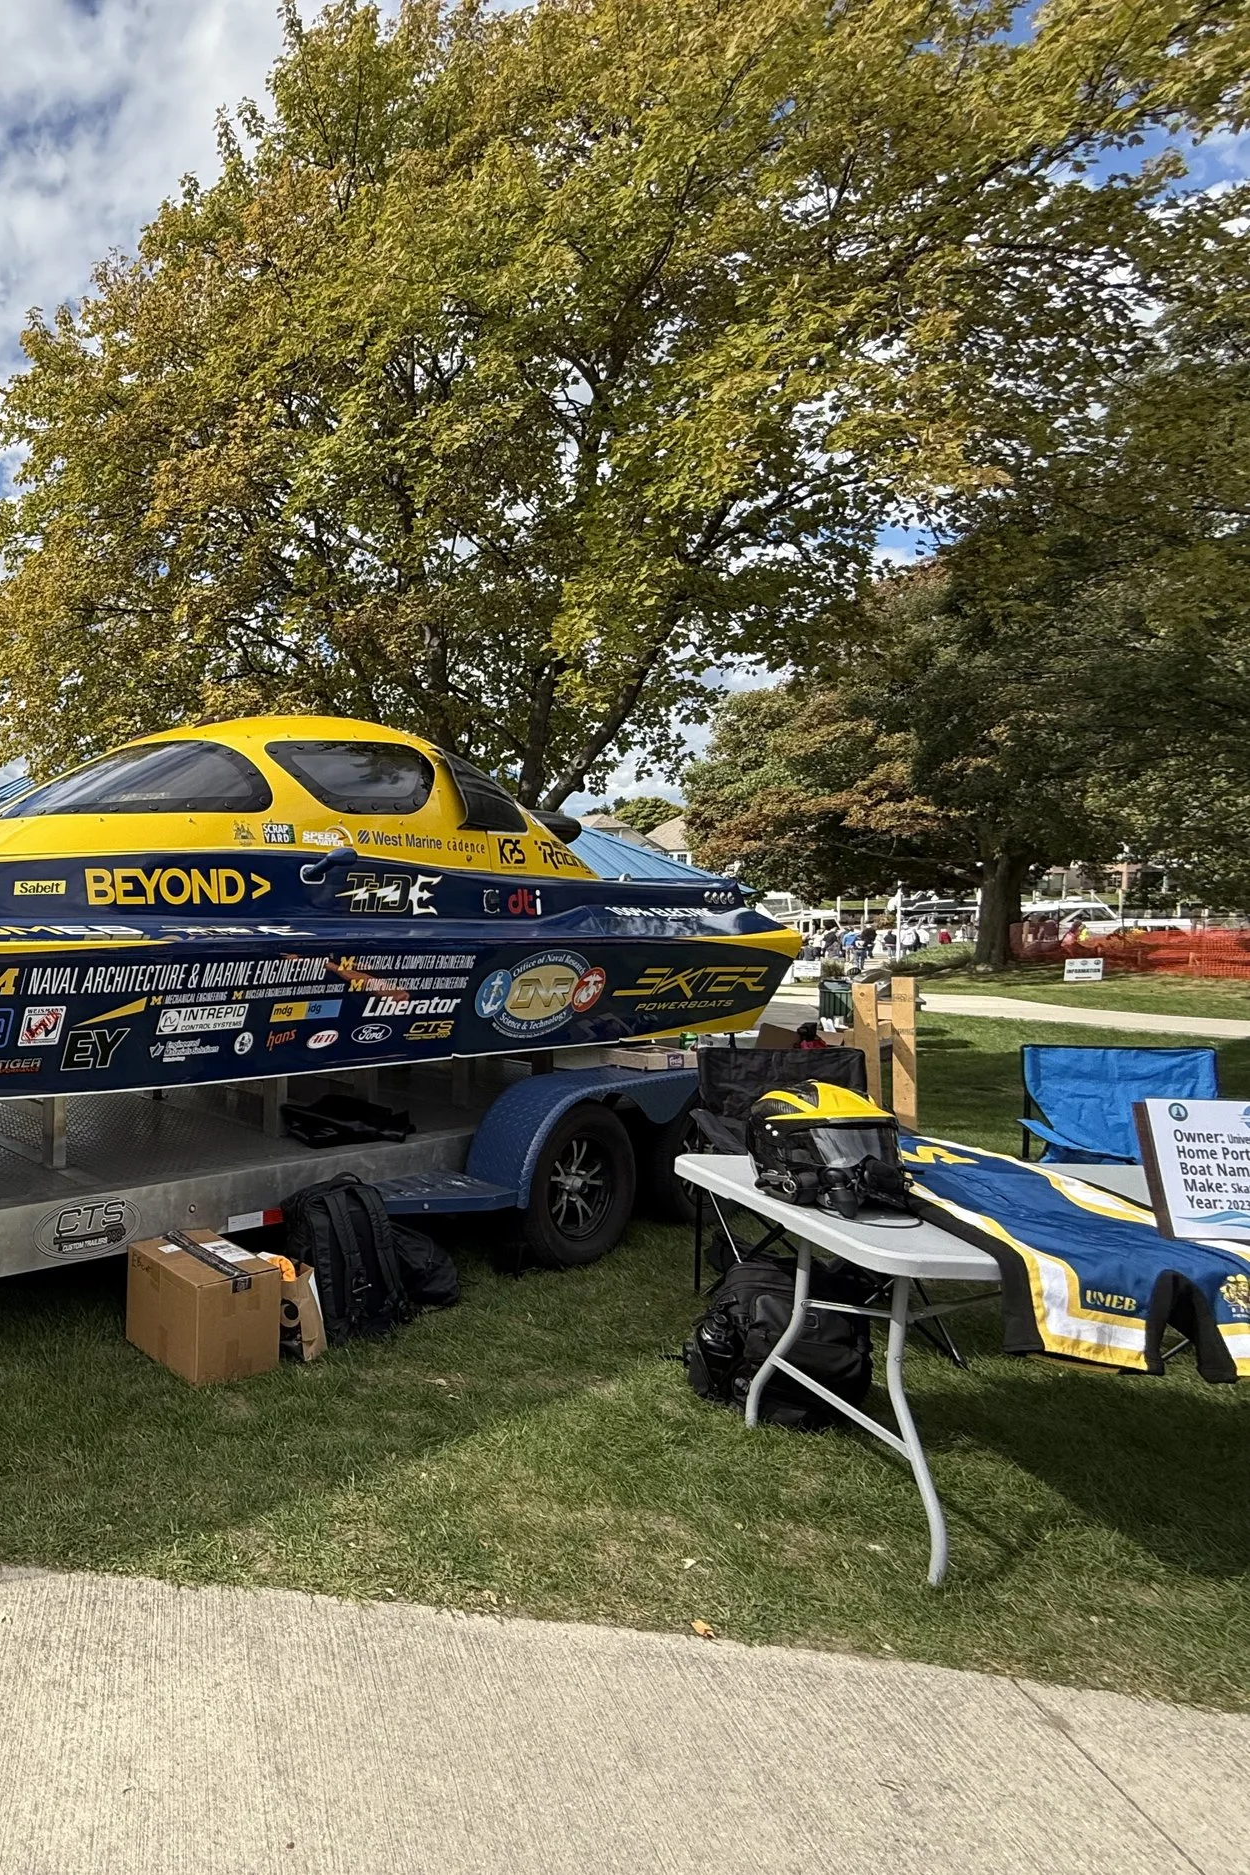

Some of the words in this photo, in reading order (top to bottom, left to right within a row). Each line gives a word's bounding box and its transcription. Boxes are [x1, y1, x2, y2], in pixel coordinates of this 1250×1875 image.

[263, 823, 289, 834] SCRAP
[302, 831, 338, 840] SPEED
[265, 833, 290, 843] YARD
[372, 831, 403, 847] West
[405, 833, 442, 850] Marine
[19, 882, 62, 894] Sabelt
[604, 907, 654, 916] 100%
[338, 956, 355, 971] M
[356, 955, 394, 970] ELECTRICAL
[395, 955, 402, 970] &
[401, 955, 436, 970] COMPUTER
[435, 954, 476, 970] ENGINEERING
[512, 960, 537, 977] Office
[536, 955, 546, 965] of
[545, 954, 566, 963] Naval
[564, 955, 586, 976] Research
[27, 967, 80, 995] NAVAL
[80, 964, 186, 994] ARCHITECTURE
[187, 963, 200, 989] &
[201, 960, 253, 988] MARINE
[253, 956, 329, 985] ENGINEERING
[244, 989, 265, 999] NUCLEAR
[264, 987, 293, 998] ENGINEERING
[325, 983, 345, 993] SCIENCES
[348, 979, 364, 992] M
[365, 977, 398, 991] COMPUTER
[397, 977, 421, 990] SCIENCE
[419, 976, 434, 989] AND
[432, 976, 469, 989] ENGINEERING
[164, 993, 196, 1004] MECHANICAL
[196, 991, 228, 1003] ENGINEERING
[183, 1005, 247, 1021] INTREPID
[273, 1005, 293, 1016] mdg
[362, 996, 461, 1018] Liberator
[634, 999, 735, 1012] POWERBOATS
[181, 1023, 211, 1032] CONTROL
[213, 1021, 242, 1029] SYSTEMS
[409, 1020, 454, 1033] CTS
[499, 1012, 521, 1030] Science
[521, 1021, 528, 1030] &
[529, 1010, 567, 1030] Technology
[266, 1029, 297, 1051] hans
[358, 1026, 385, 1040] Ford
[61, 1028, 130, 1071] EY
[1174, 1129, 1225, 1144] Owner:
[1176, 1145, 1218, 1160] Home
[1179, 1162, 1213, 1176] Boat
[1183, 1178, 1229, 1193] Make:
[1186, 1195, 1225, 1209] Year:
[55, 1200, 126, 1236] CTS
[62, 1242, 84, 1252] CUSTOM
[85, 1236, 109, 1248] TRAILERS
[1085, 1289, 1137, 1311] UMEB
